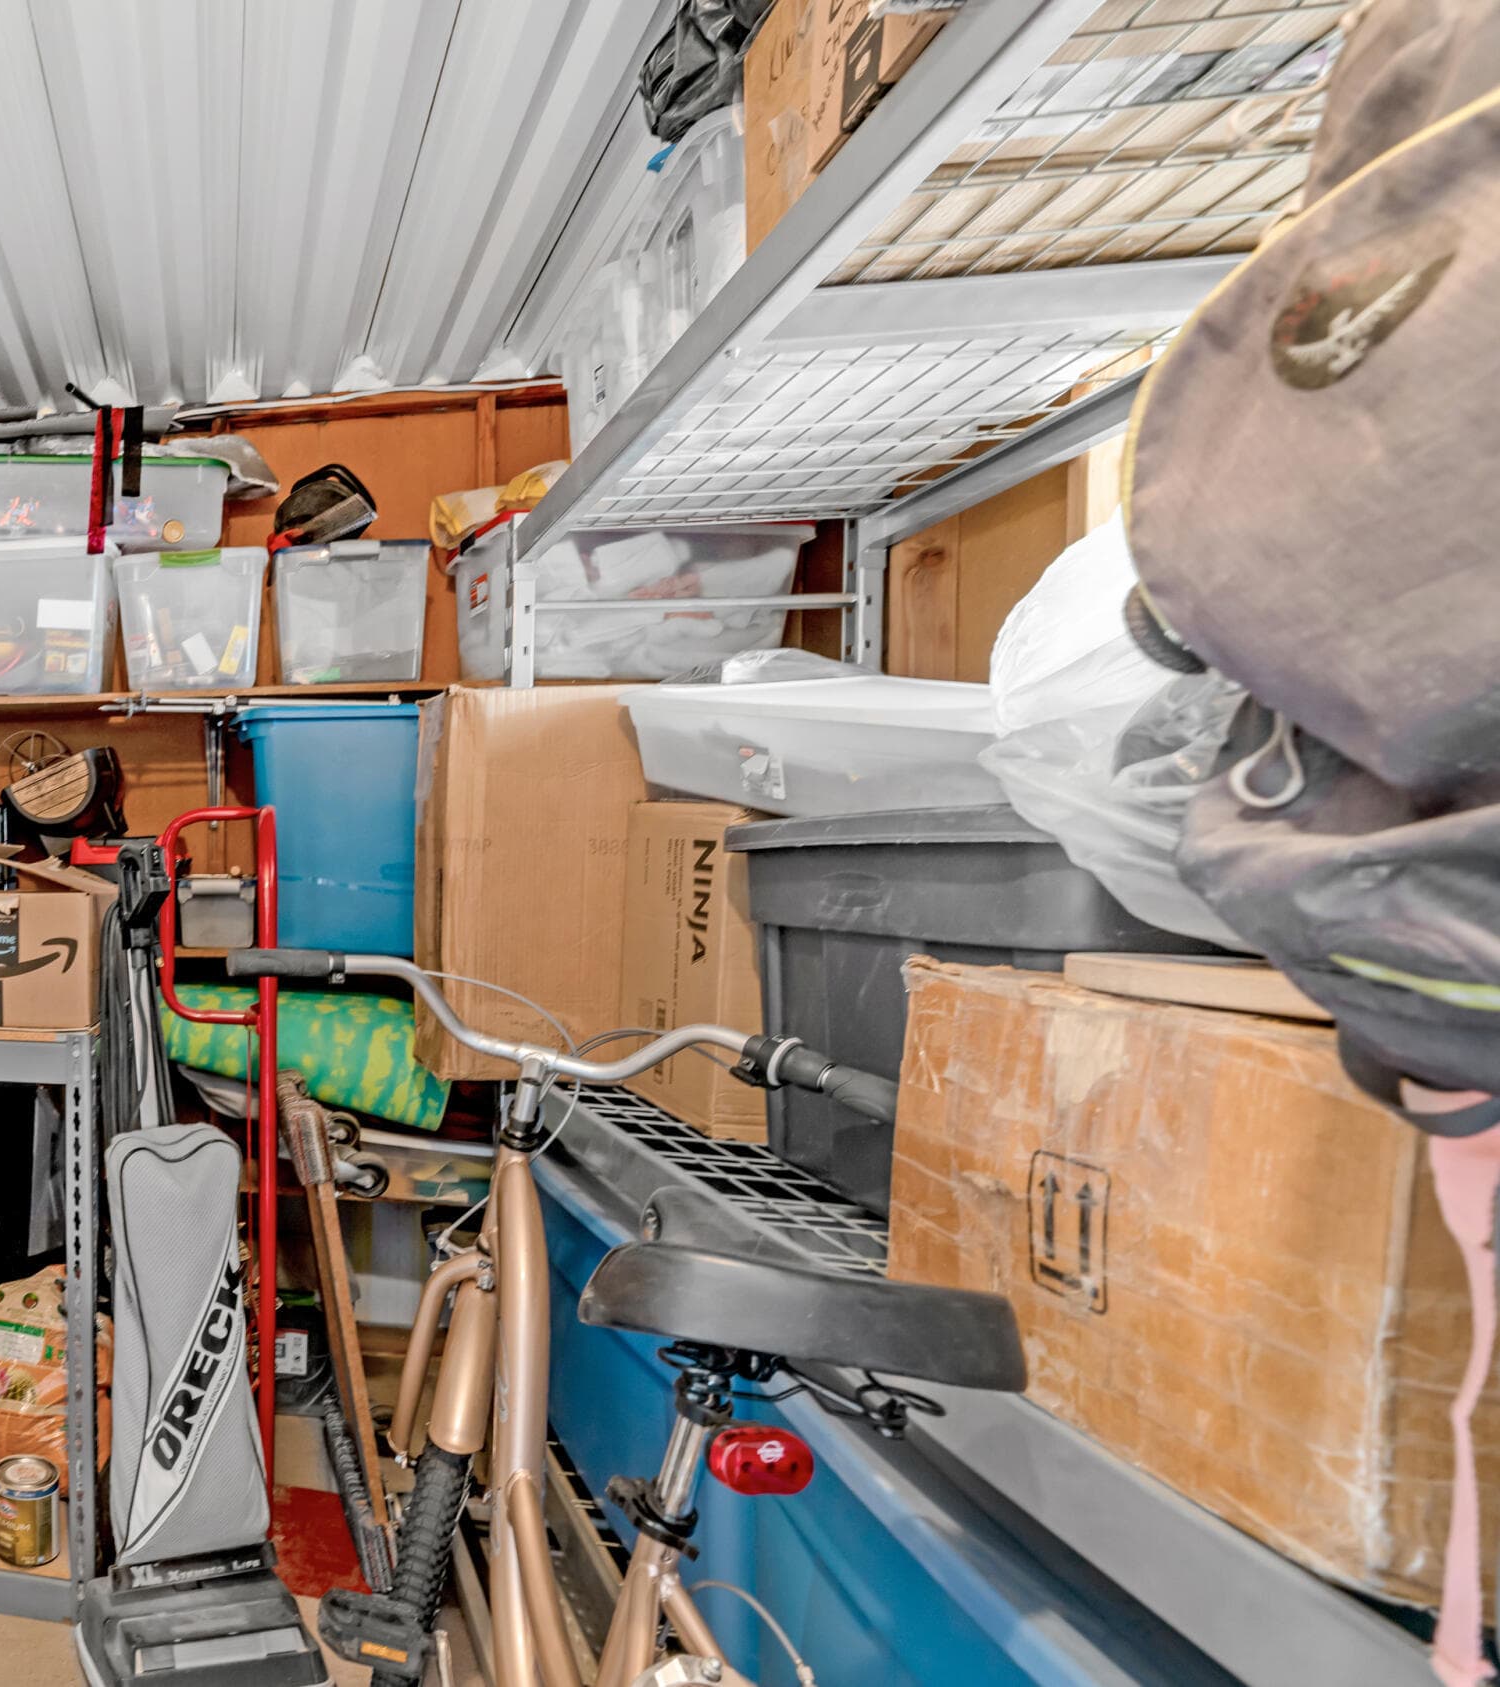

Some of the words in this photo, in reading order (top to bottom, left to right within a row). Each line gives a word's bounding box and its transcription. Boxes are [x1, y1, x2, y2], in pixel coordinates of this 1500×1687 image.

[685, 839, 718, 965] NINJA
[153, 1262, 242, 1471] ORECK
[130, 1565, 163, 1588] XL
